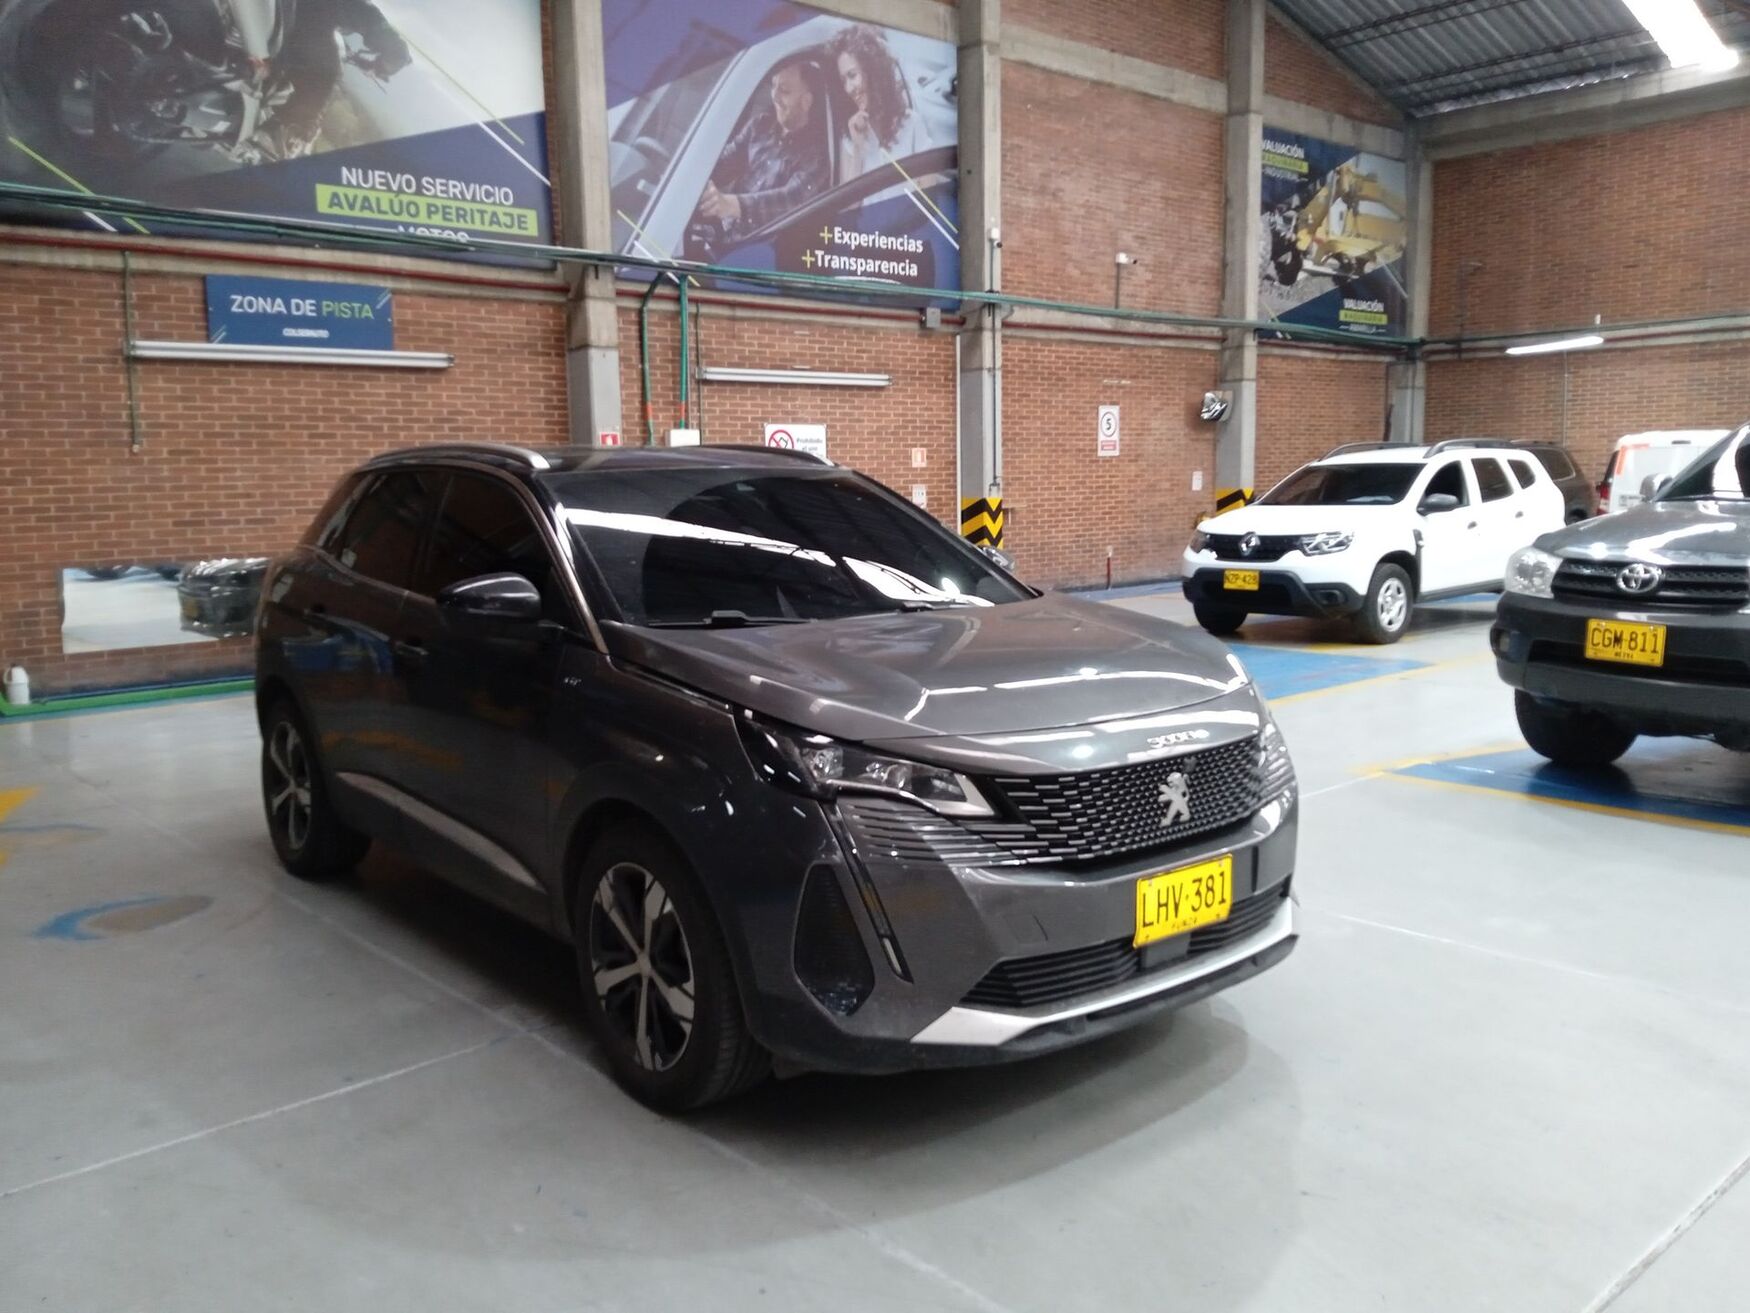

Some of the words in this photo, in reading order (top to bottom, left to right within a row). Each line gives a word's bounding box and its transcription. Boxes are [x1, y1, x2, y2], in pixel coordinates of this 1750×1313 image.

[341, 166, 416, 193] NUEVO
[421, 176, 514, 205] SERVICIO
[328, 191, 420, 218] AVALÚO
[426, 203, 528, 230] PERITAJE
[229, 295, 287, 315] ZONA
[291, 299, 317, 317] DE
[322, 301, 374, 319] PISTA
[1106, 418, 1112, 430] 5
